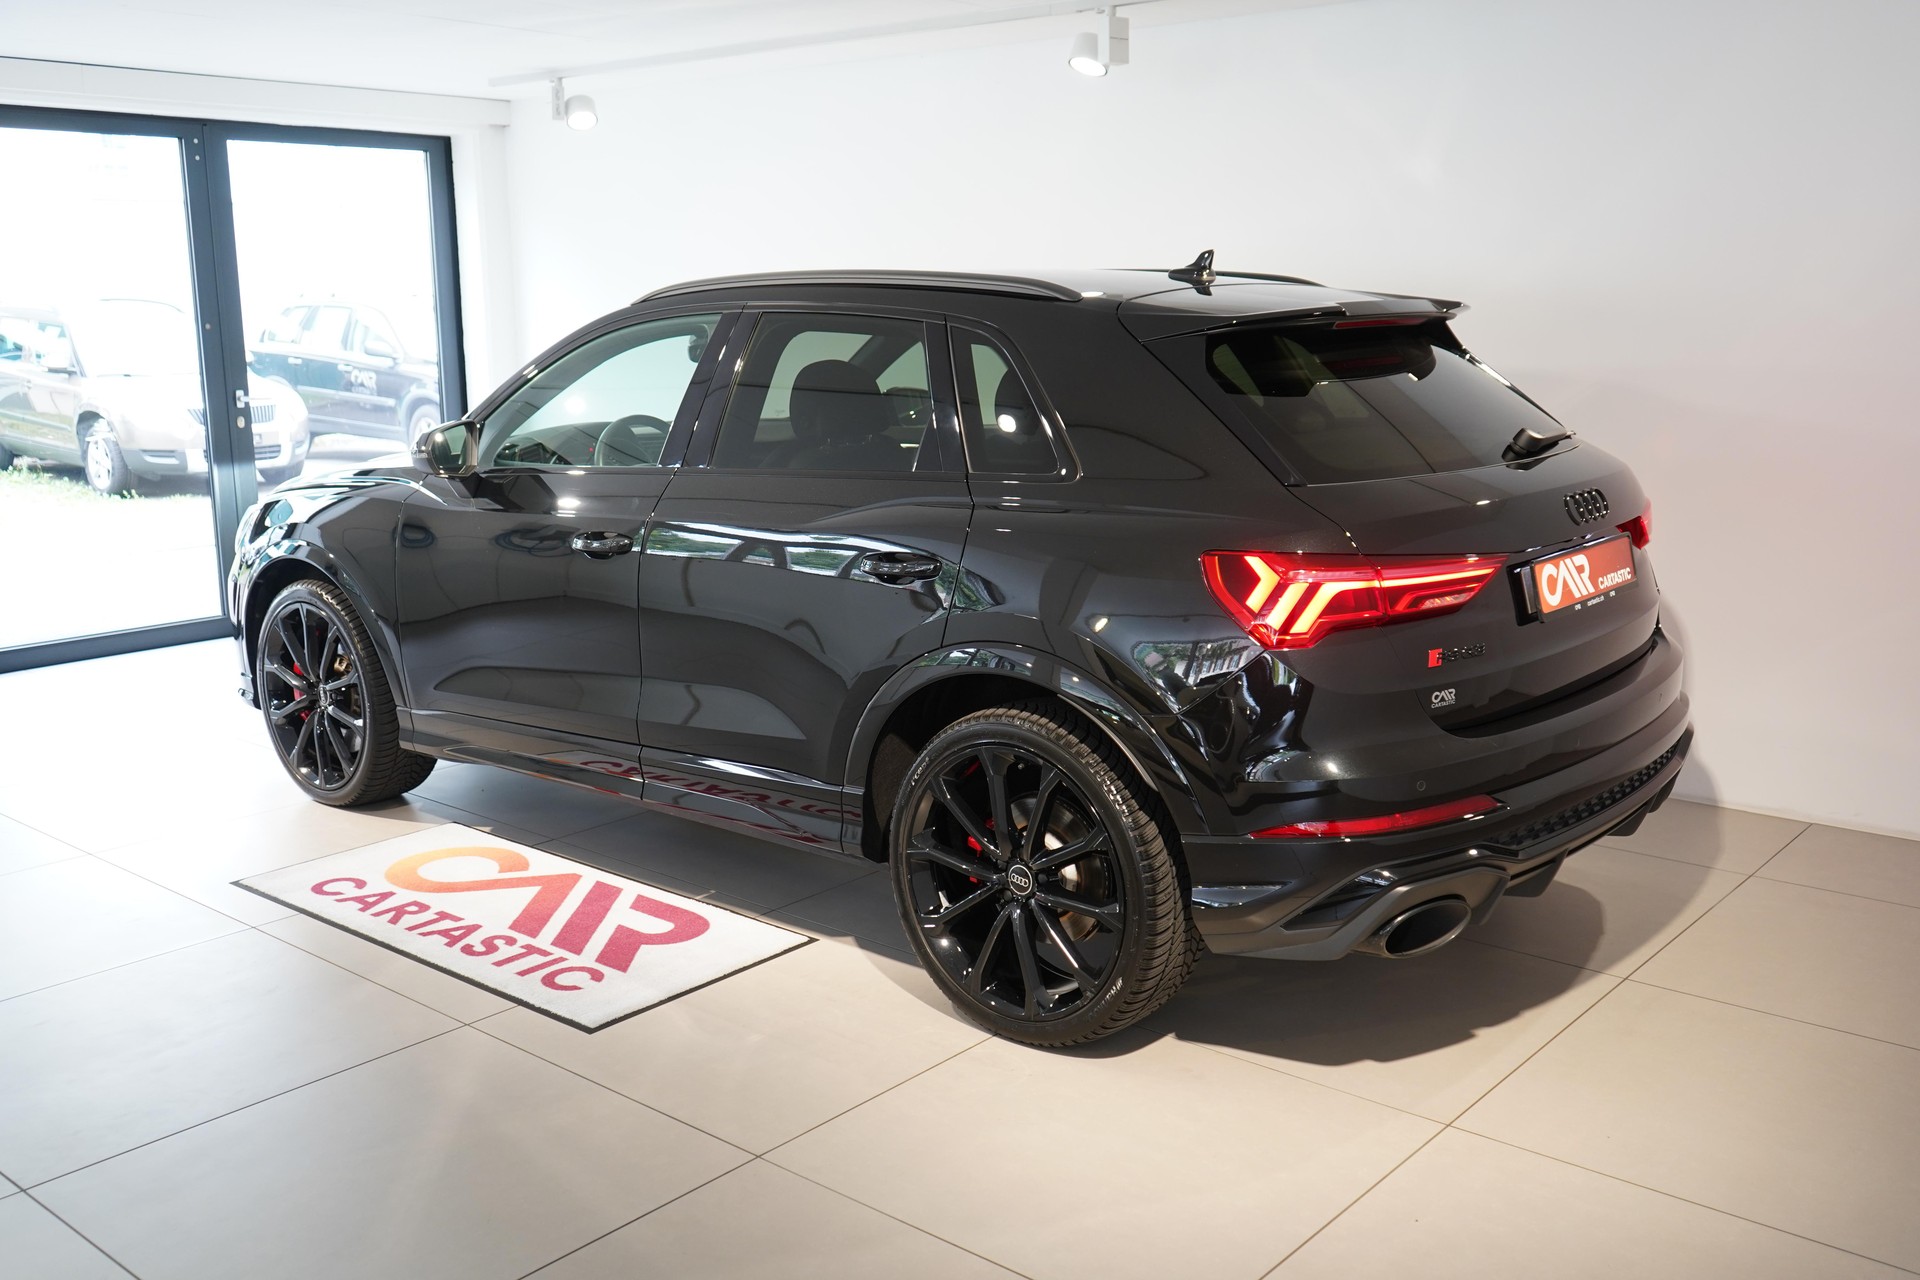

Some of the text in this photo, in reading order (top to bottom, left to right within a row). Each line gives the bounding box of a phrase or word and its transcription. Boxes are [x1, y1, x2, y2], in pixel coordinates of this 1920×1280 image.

[1541, 554, 1632, 606] CAR CARTASTIC
[1431, 688, 1456, 703] CAR
[1431, 699, 1456, 708] CARTASTIC
[310, 877, 605, 992] CARTASTIC
[384, 846, 710, 974] CAR
